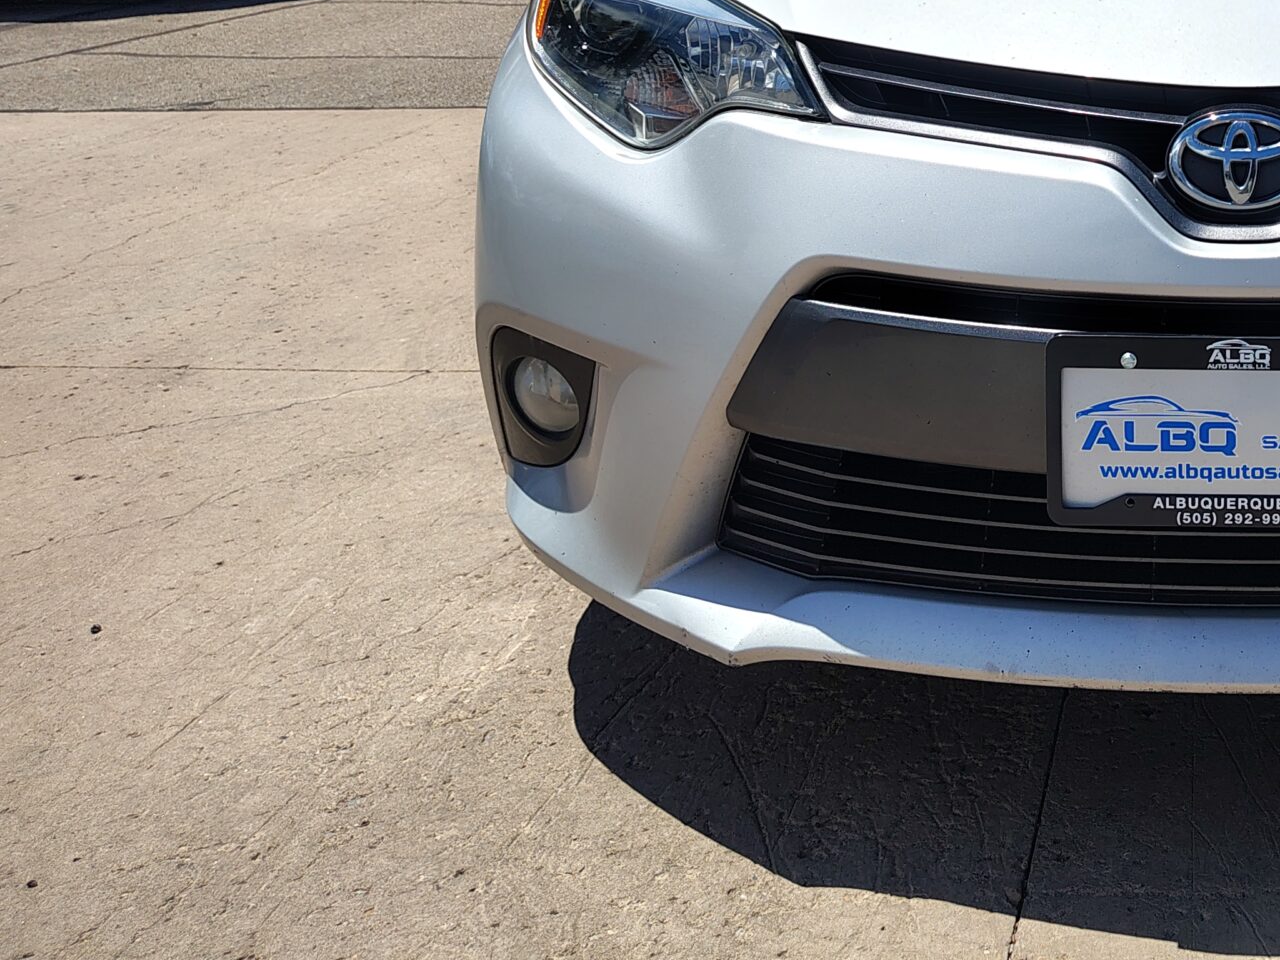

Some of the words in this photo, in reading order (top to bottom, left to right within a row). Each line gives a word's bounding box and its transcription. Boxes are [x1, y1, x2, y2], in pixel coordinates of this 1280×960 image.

[1208, 349, 1271, 367] ALBQ
[1081, 419, 1239, 458] ALBQ
[1176, 512, 1217, 526] (505)
